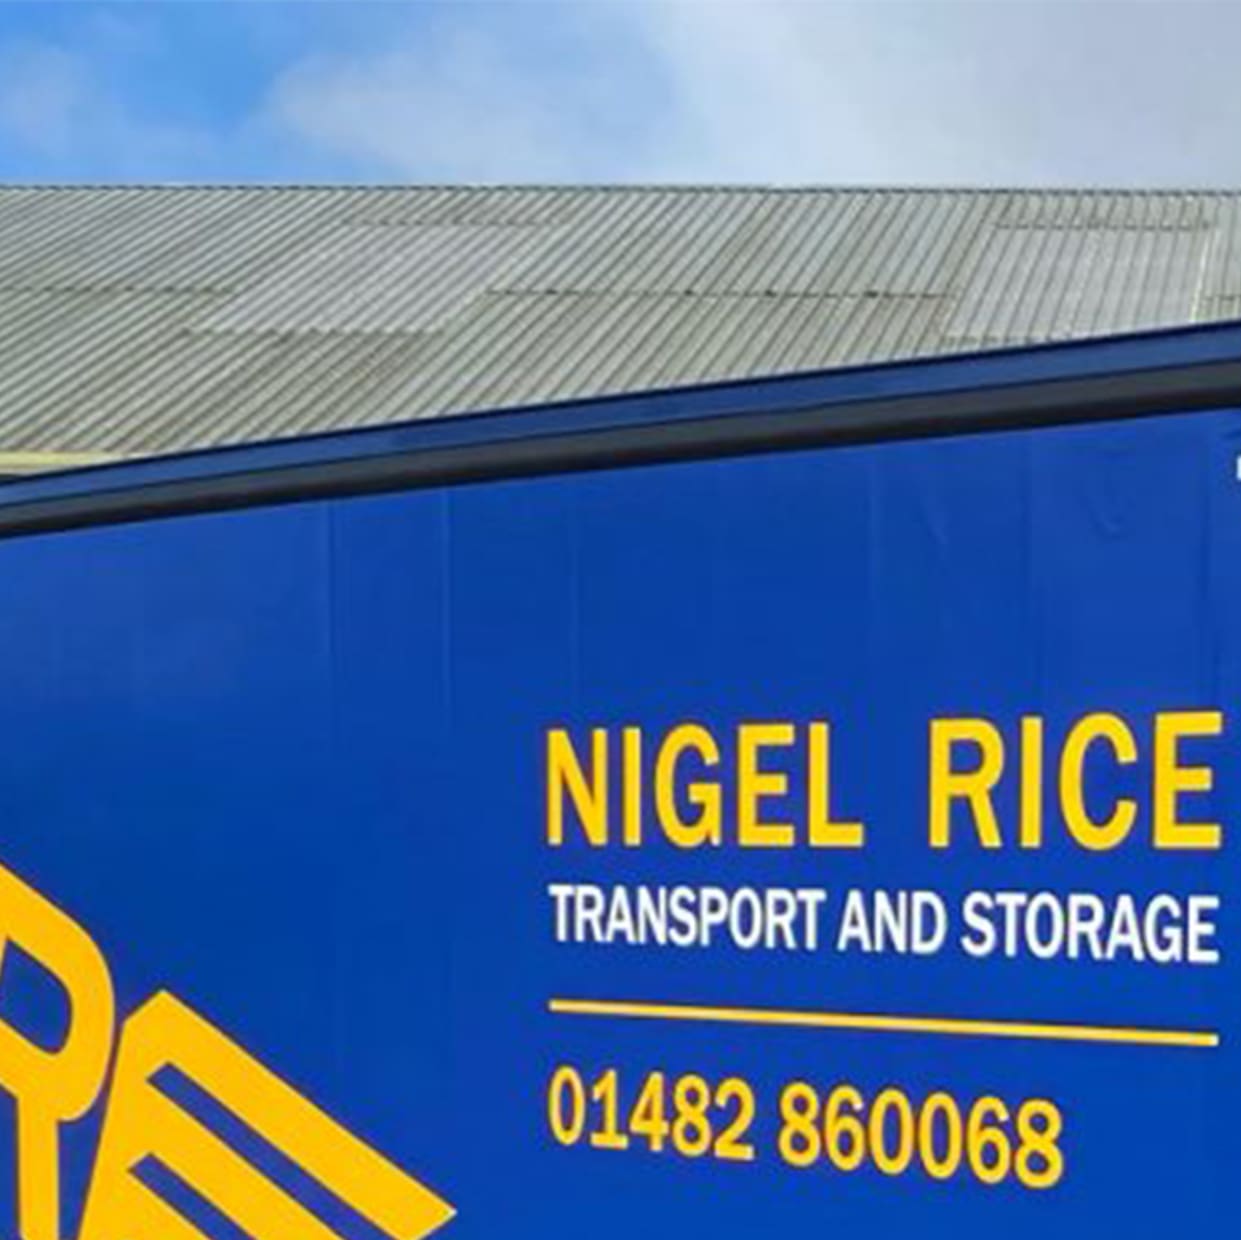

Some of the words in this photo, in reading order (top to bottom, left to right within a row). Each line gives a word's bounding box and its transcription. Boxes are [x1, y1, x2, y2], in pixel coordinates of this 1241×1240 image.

[546, 721, 864, 848] NIGEL
[929, 711, 1223, 851] RICE
[547, 884, 827, 950] TRANSPORT
[837, 889, 947, 954] AND
[961, 891, 1219, 964] STORAGE
[548, 1066, 755, 1161] 01482
[778, 1082, 1064, 1189] 860068
